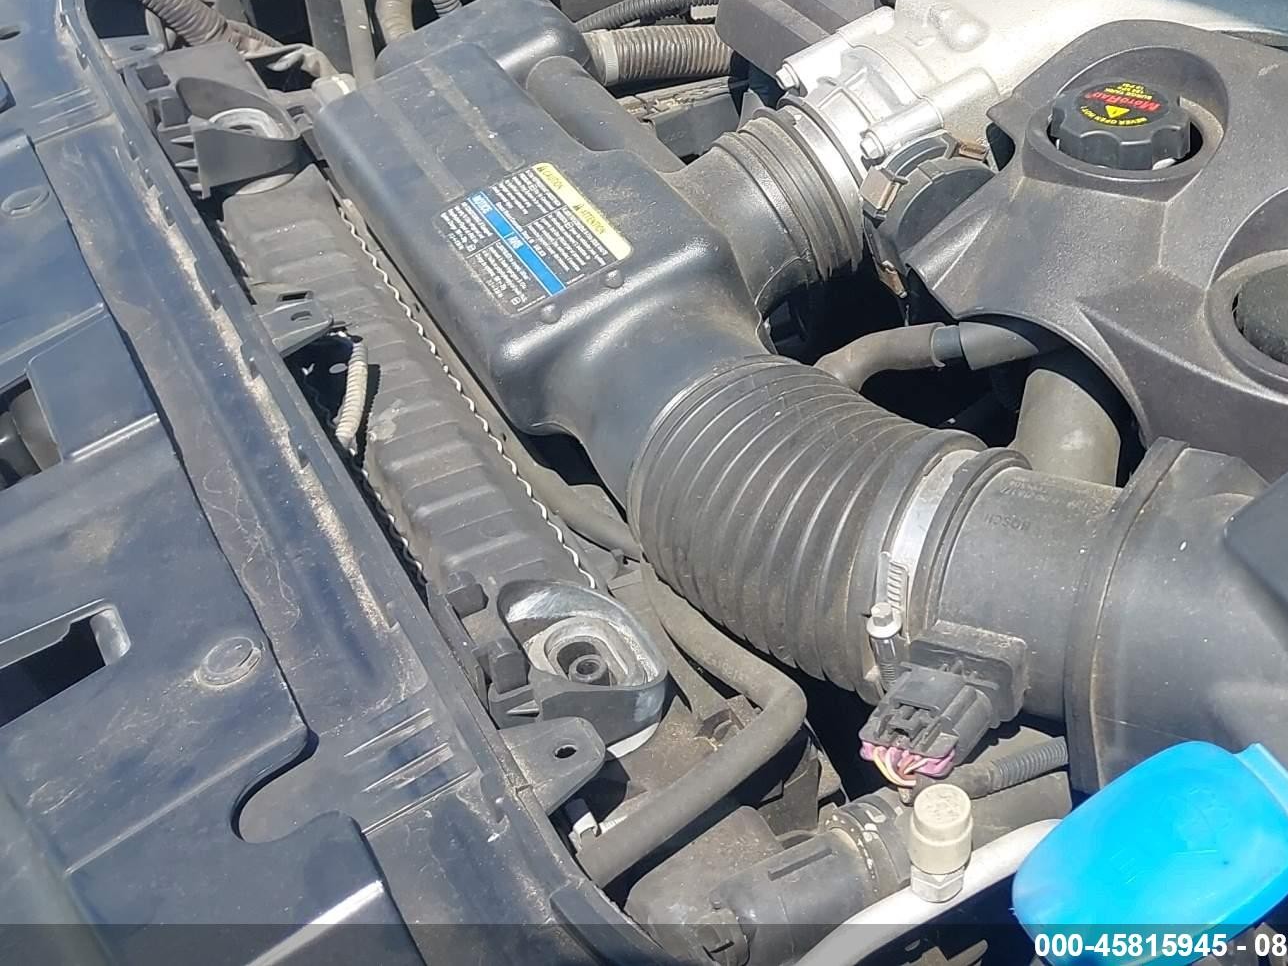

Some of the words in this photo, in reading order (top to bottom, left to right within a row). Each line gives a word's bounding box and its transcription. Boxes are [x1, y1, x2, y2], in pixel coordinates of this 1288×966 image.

[1094, 115, 1118, 125] OPEN
[1118, 117, 1148, 125] NEVER
[578, 208, 608, 234] ATTENTION
